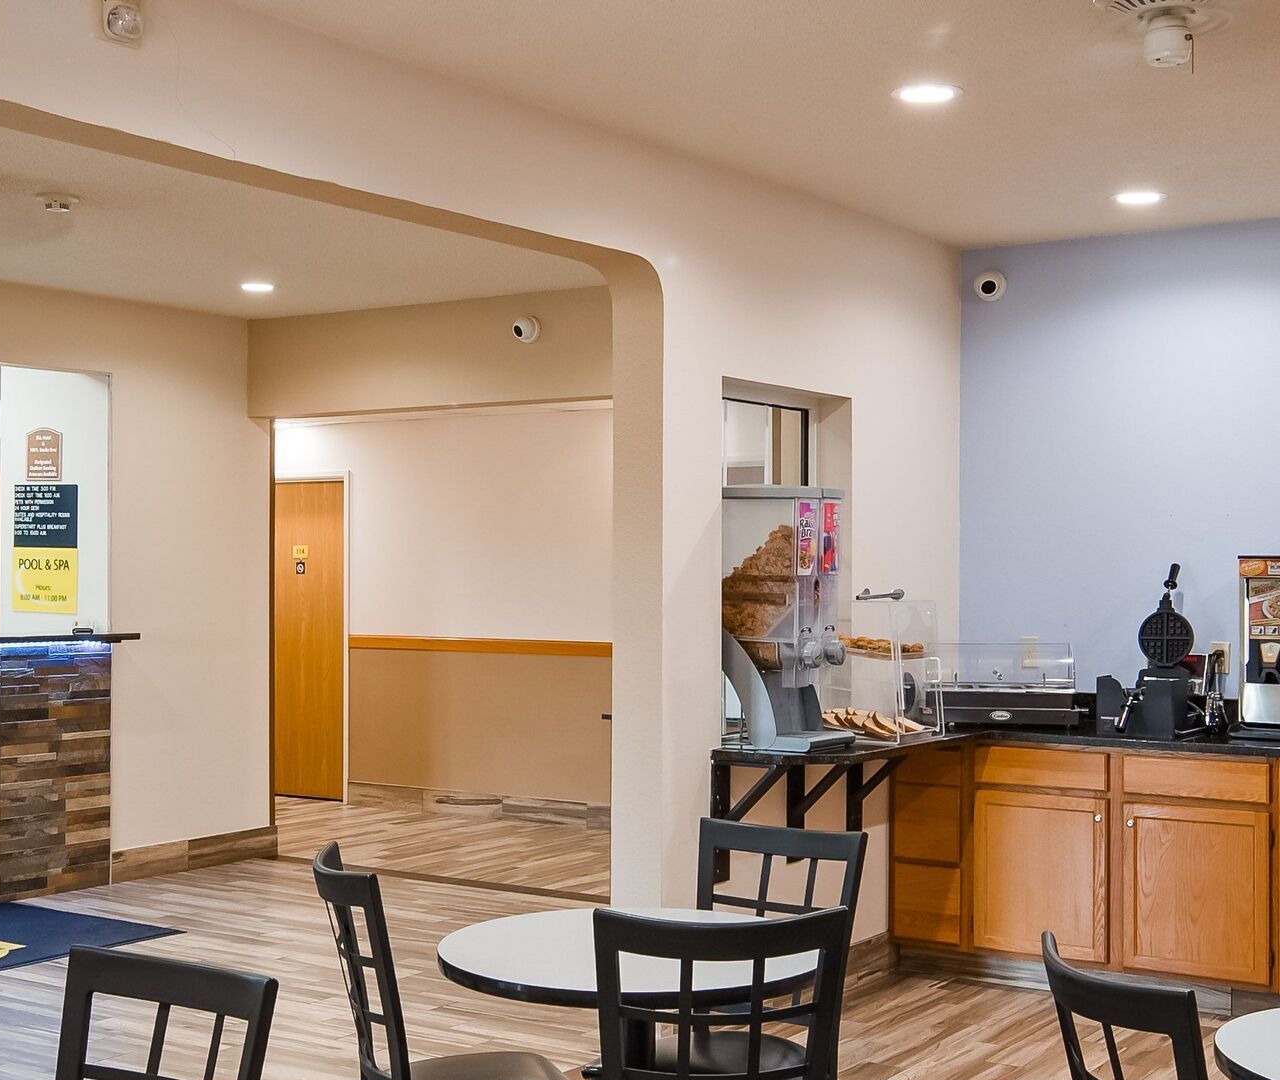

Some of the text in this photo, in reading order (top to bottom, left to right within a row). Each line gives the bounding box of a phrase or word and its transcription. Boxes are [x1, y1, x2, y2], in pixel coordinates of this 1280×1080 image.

[18, 558, 70, 570] POOL & SPA
